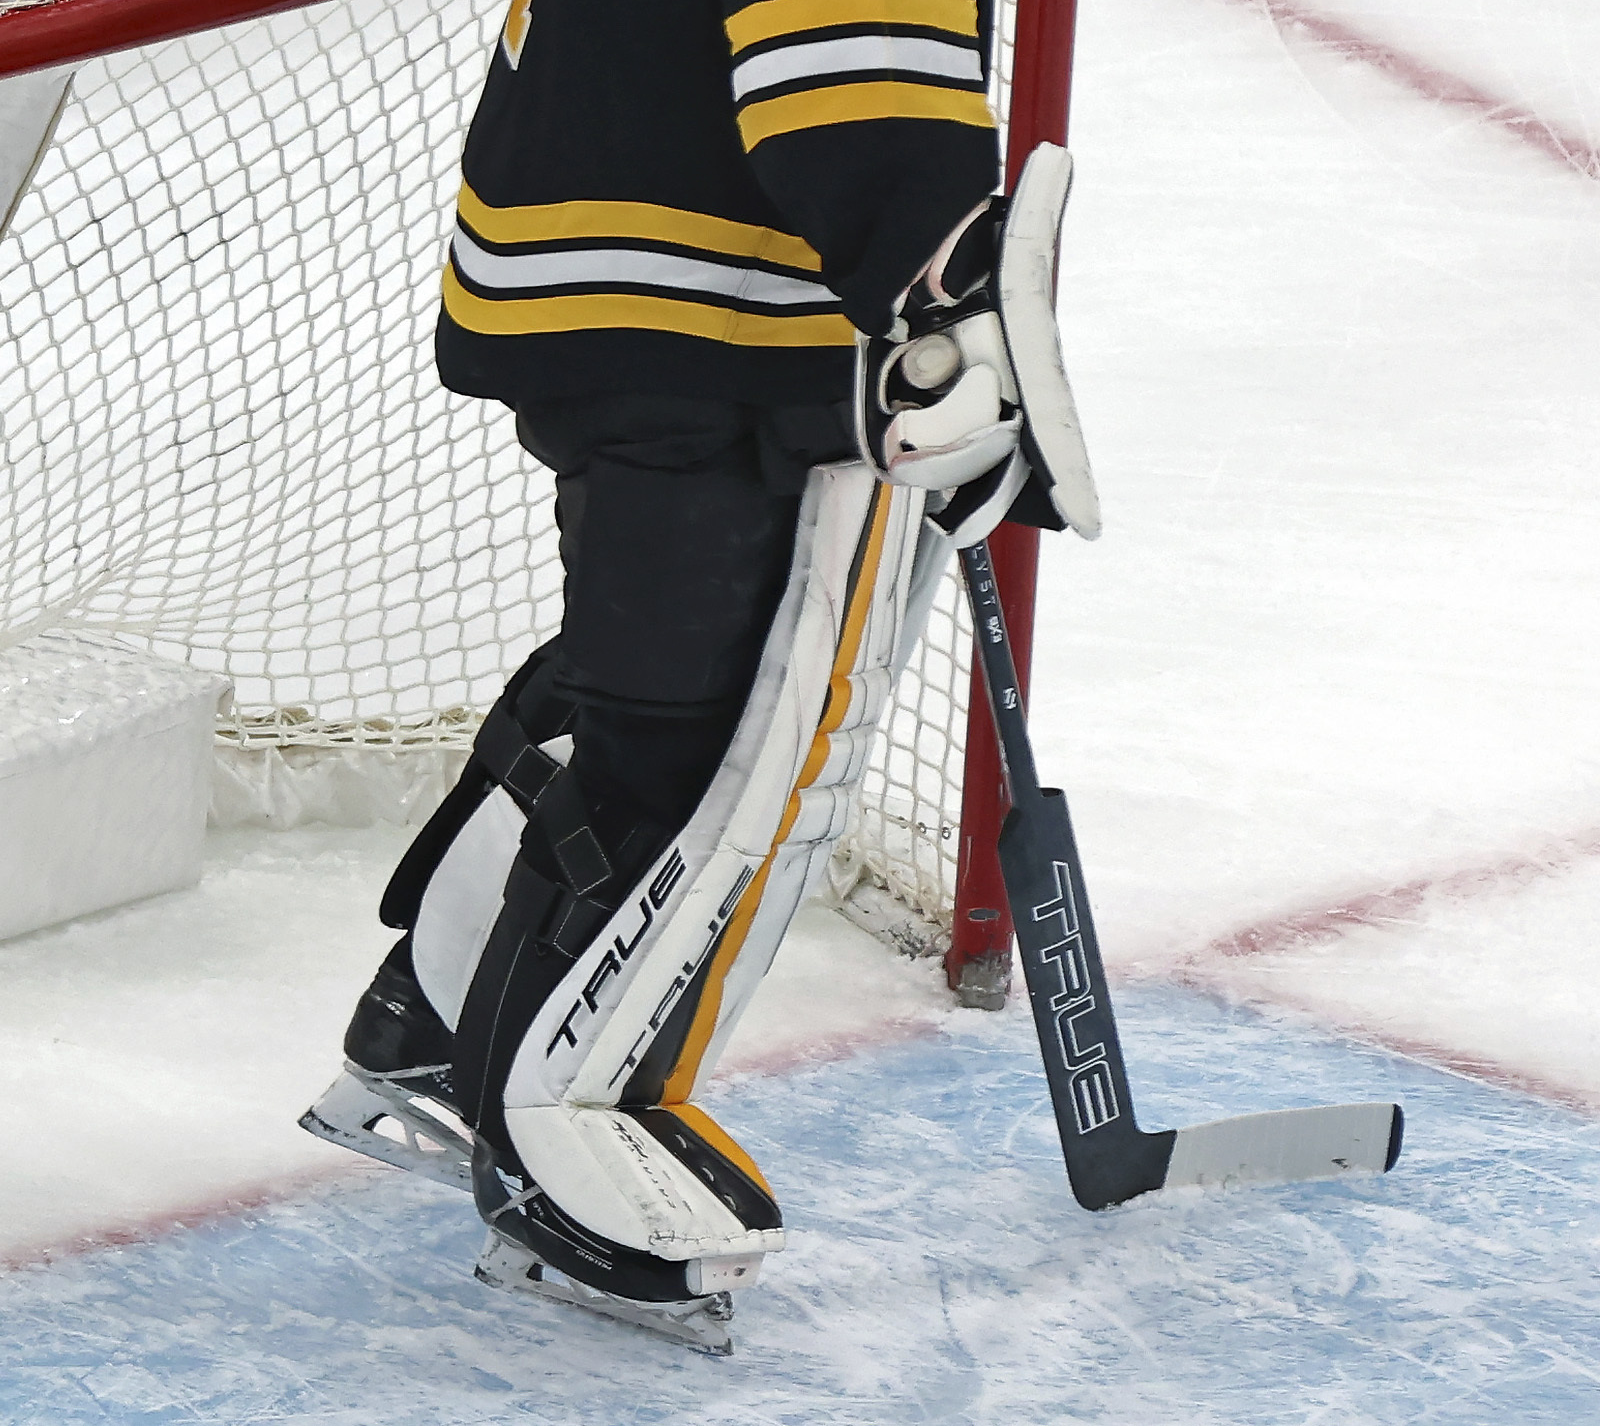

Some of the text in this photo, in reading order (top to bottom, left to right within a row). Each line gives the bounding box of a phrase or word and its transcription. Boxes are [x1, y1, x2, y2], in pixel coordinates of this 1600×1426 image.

[546, 846, 687, 1060] TRUE
[608, 863, 756, 1091] TRUE
[1031, 860, 1121, 1135] TRUE
